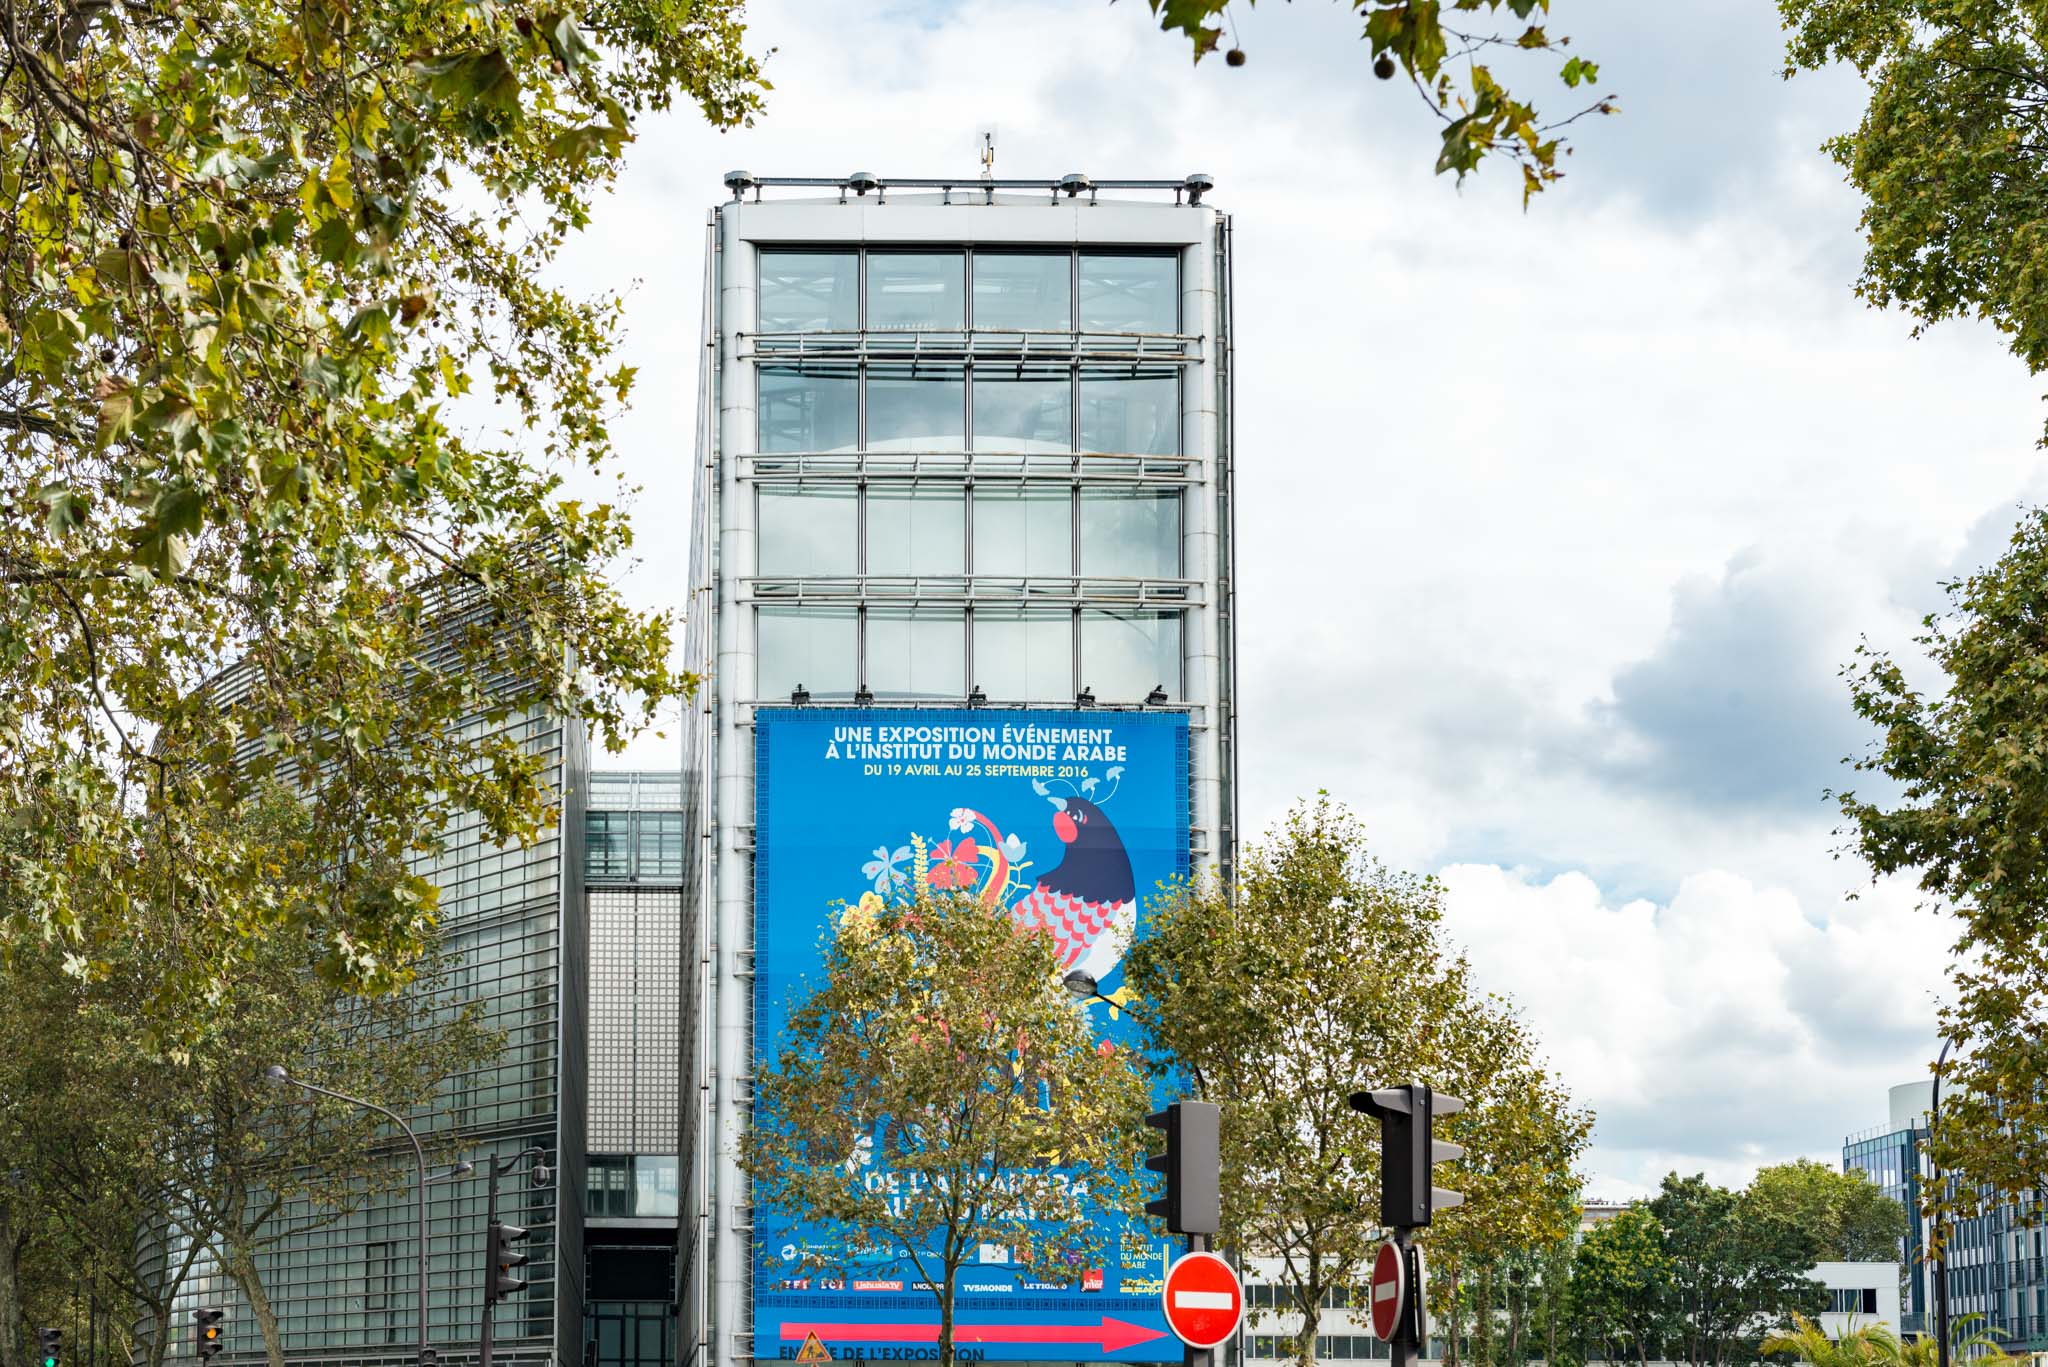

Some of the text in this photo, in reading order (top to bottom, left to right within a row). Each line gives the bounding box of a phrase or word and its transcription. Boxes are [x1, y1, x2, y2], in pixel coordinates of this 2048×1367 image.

[834, 723, 1112, 744] UNE EXPOSITION ÉVÉNEMENT
[825, 739, 1127, 762] À L'INSTITUT DU MONDE ARABE
[864, 764, 1088, 777] DU 19 AVRIL AU 25 SEPTEMBRE 2016
[865, 1172, 899, 1195] DE
[1120, 1252, 1163, 1260] DU MONDE
[1120, 1261, 1147, 1269] ABE
[963, 1284, 1013, 1292] TV5MONDE
[779, 1343, 984, 1361] ENE DE L'EXPOSION
